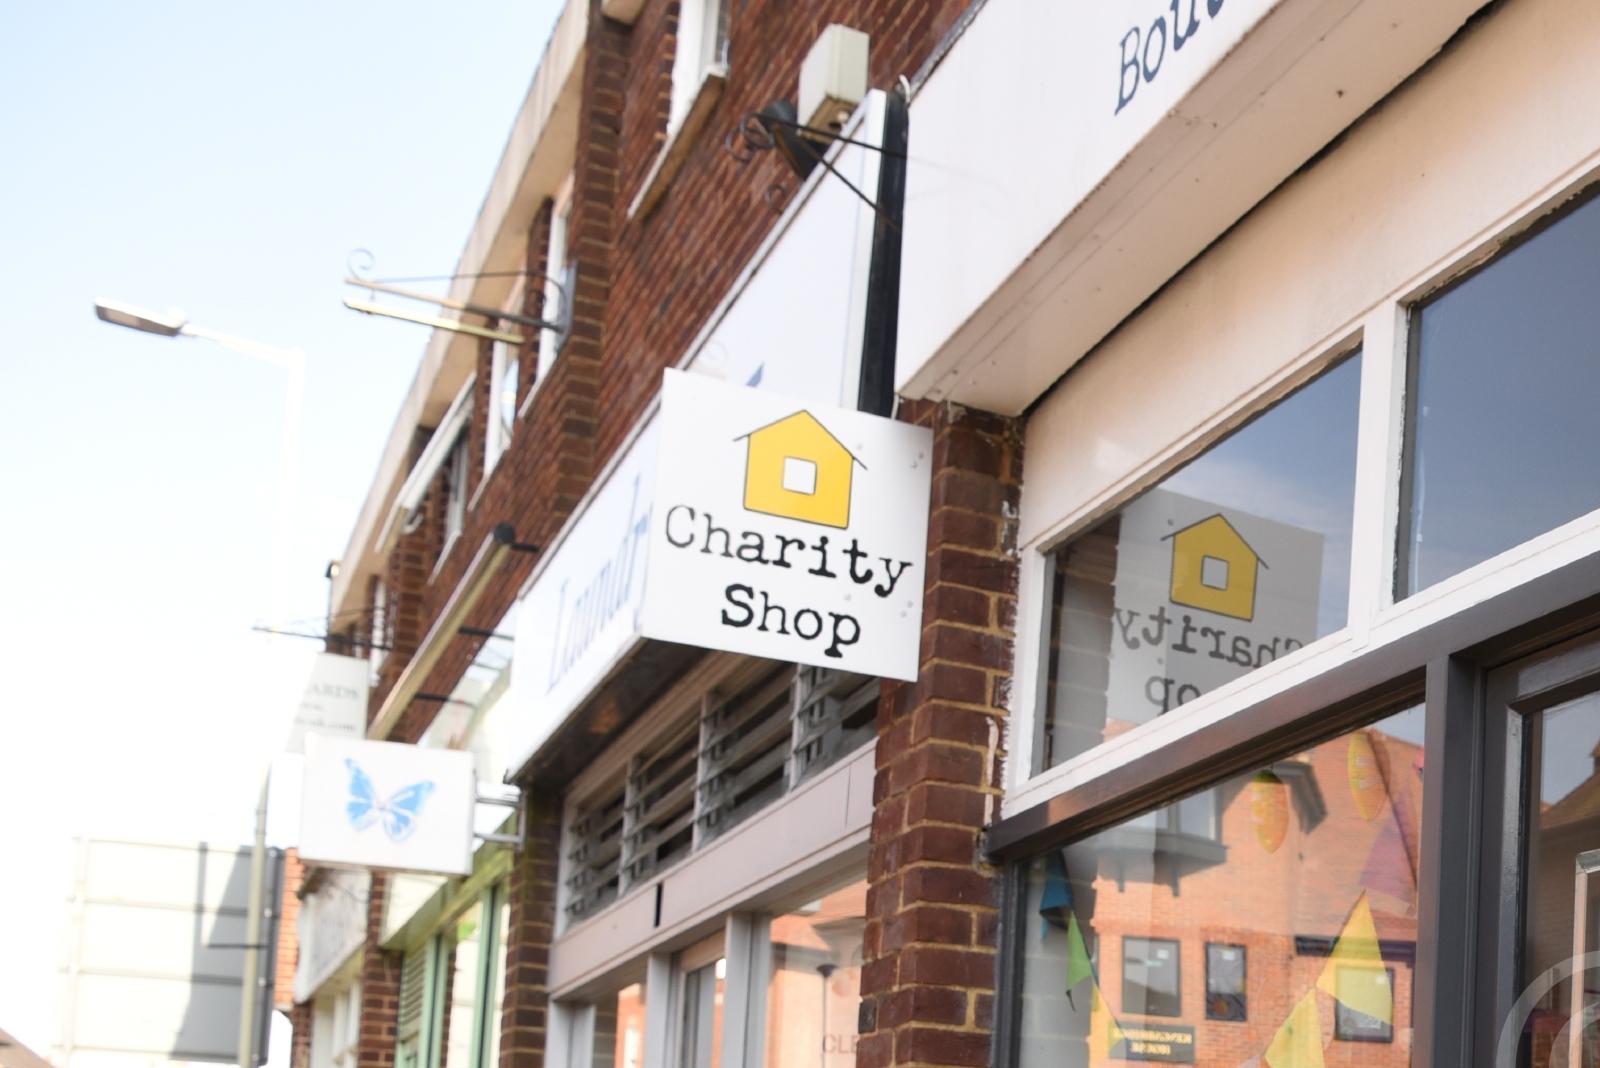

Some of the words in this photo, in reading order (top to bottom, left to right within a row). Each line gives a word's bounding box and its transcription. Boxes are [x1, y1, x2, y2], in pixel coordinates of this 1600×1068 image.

[1113, 0, 1224, 116] Bou
[666, 505, 913, 597] Charity
[722, 584, 861, 658] Shop
